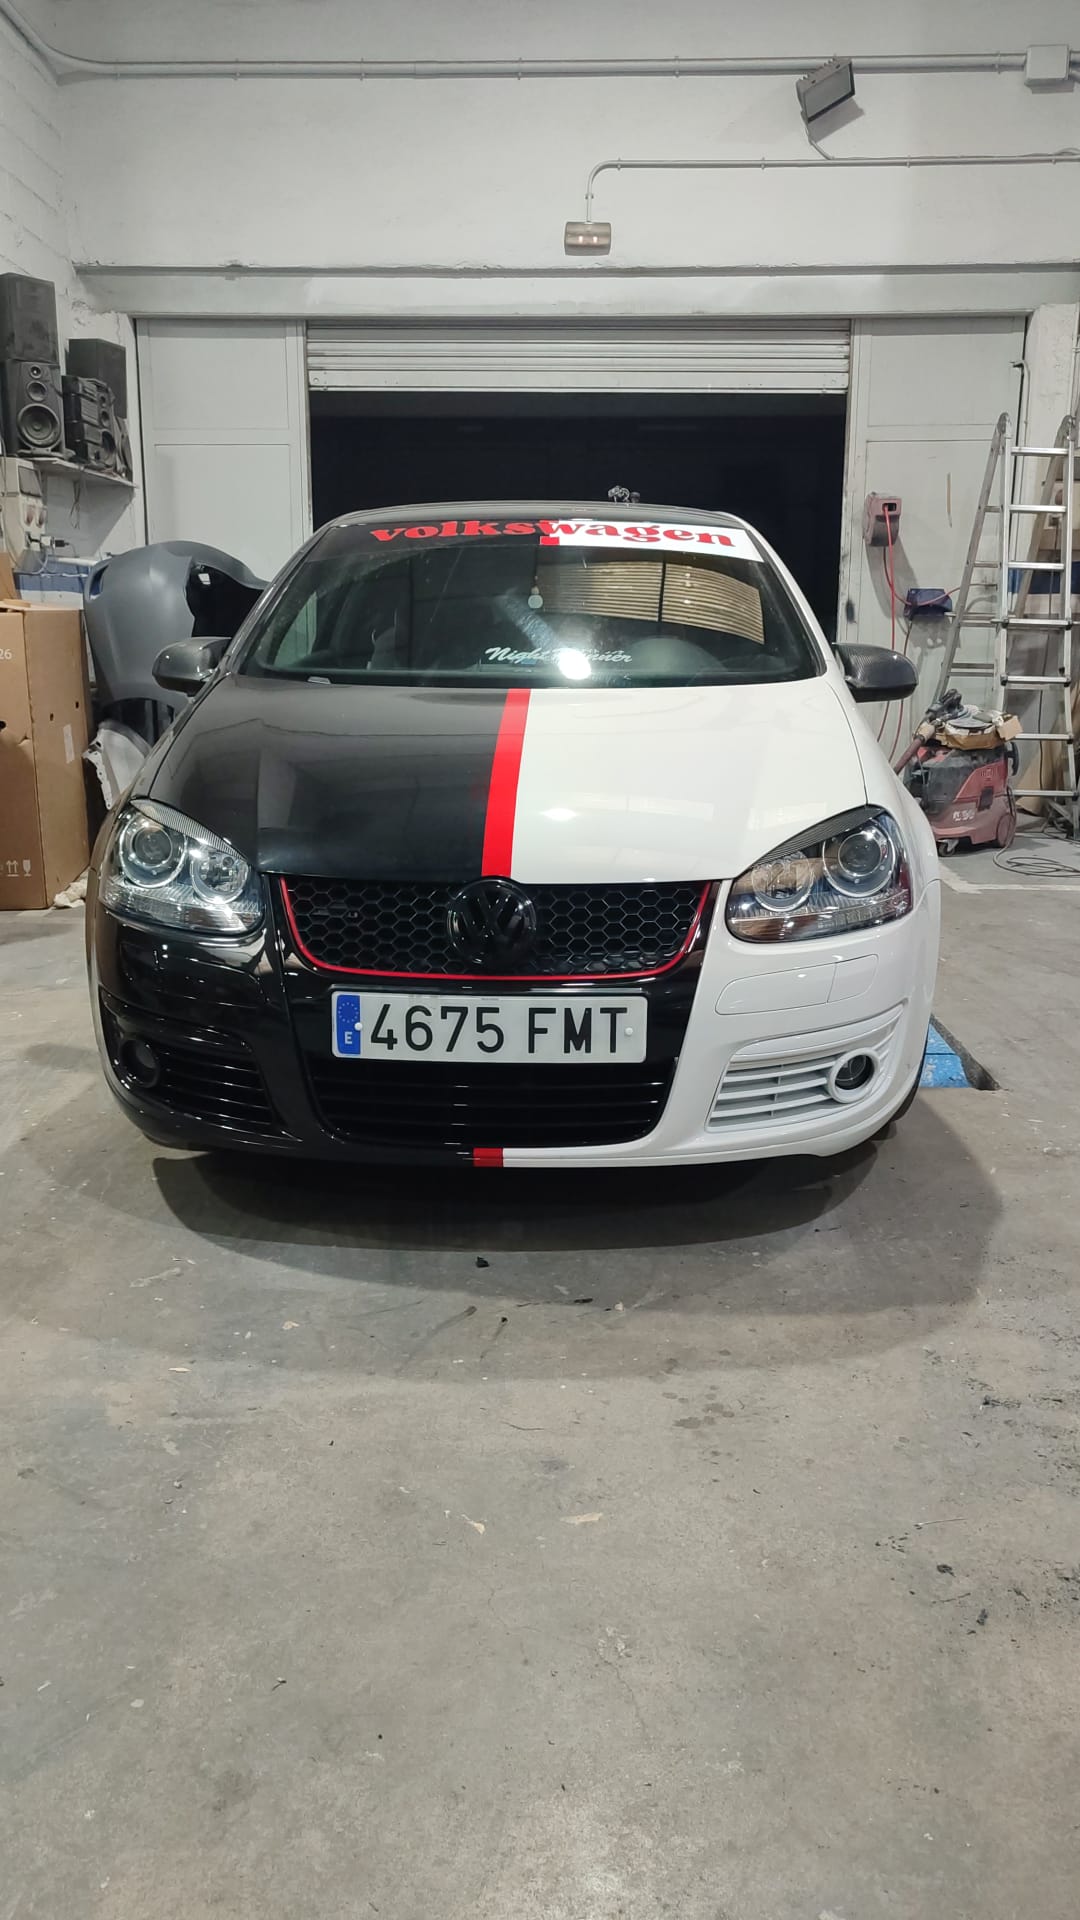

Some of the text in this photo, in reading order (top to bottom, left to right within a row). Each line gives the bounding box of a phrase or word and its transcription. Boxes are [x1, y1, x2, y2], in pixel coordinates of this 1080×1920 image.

[370, 520, 736, 547] volkswagen
[344, 1031, 353, 1045] E
[370, 1003, 628, 1054] 4675 FMT
